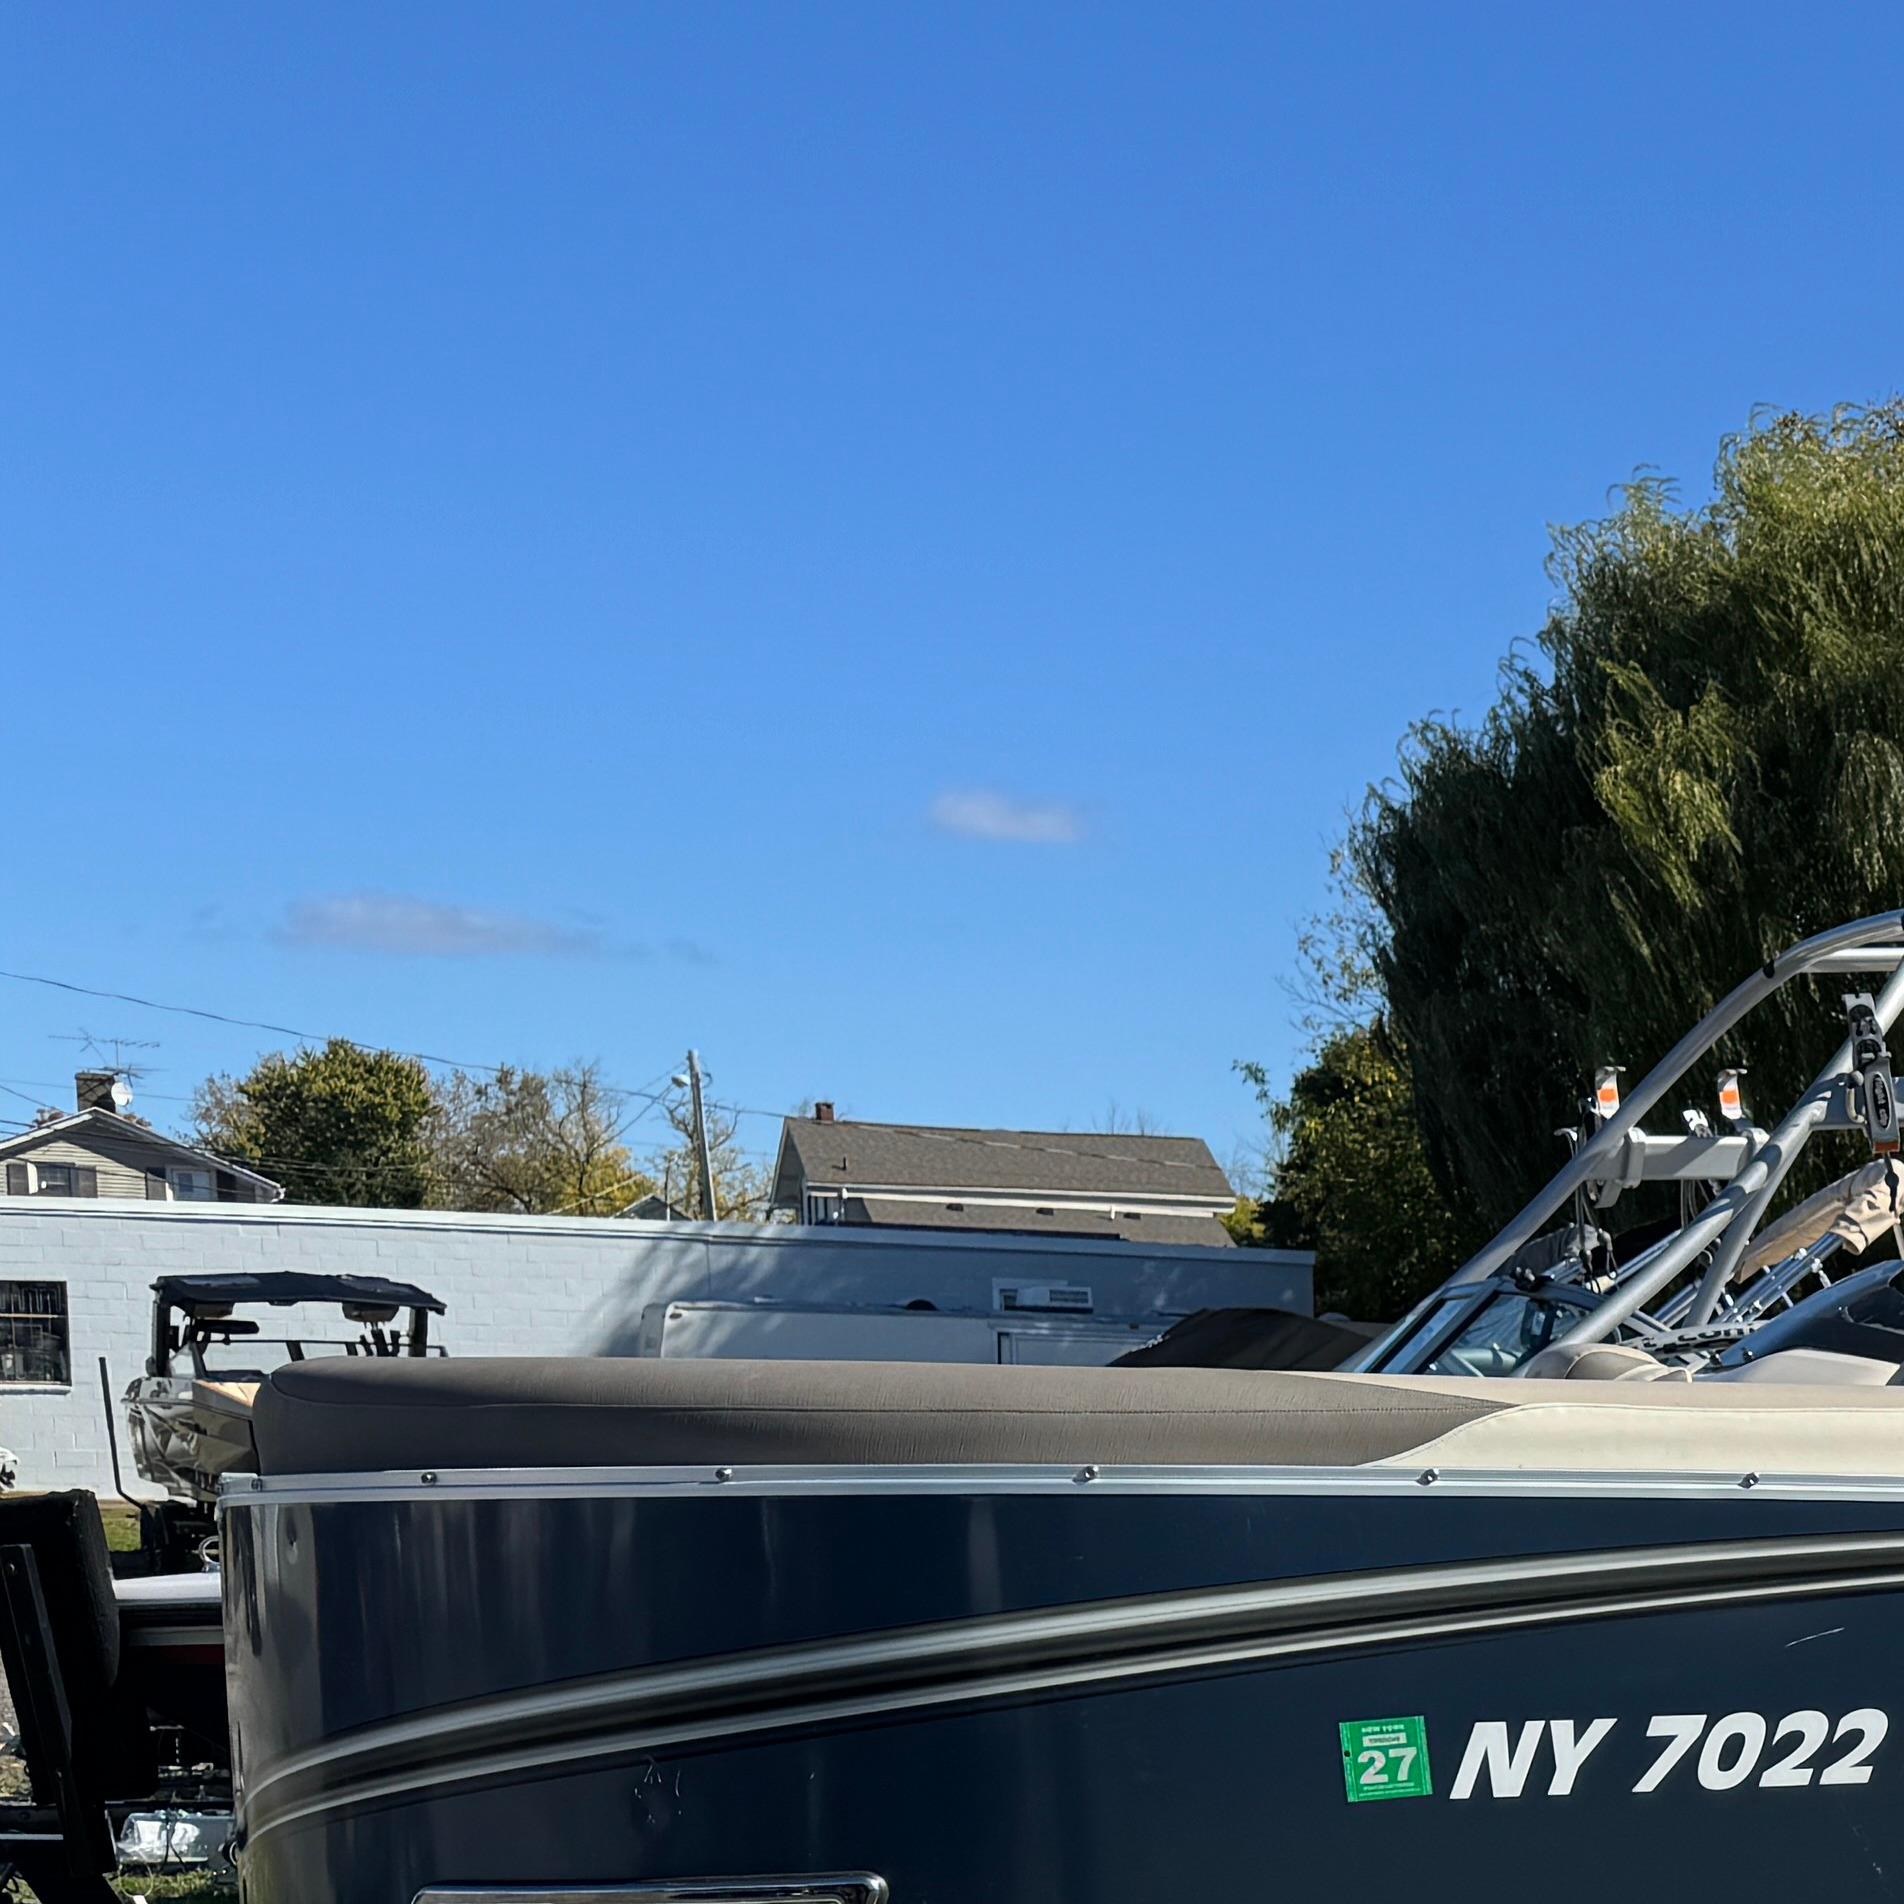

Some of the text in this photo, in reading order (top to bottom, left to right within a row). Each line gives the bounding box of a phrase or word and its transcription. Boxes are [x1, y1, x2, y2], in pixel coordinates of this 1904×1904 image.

[1358, 1747, 1417, 1784] 27
[1450, 1718, 1617, 1799] NY
[1632, 1709, 1888, 1792] 7022
